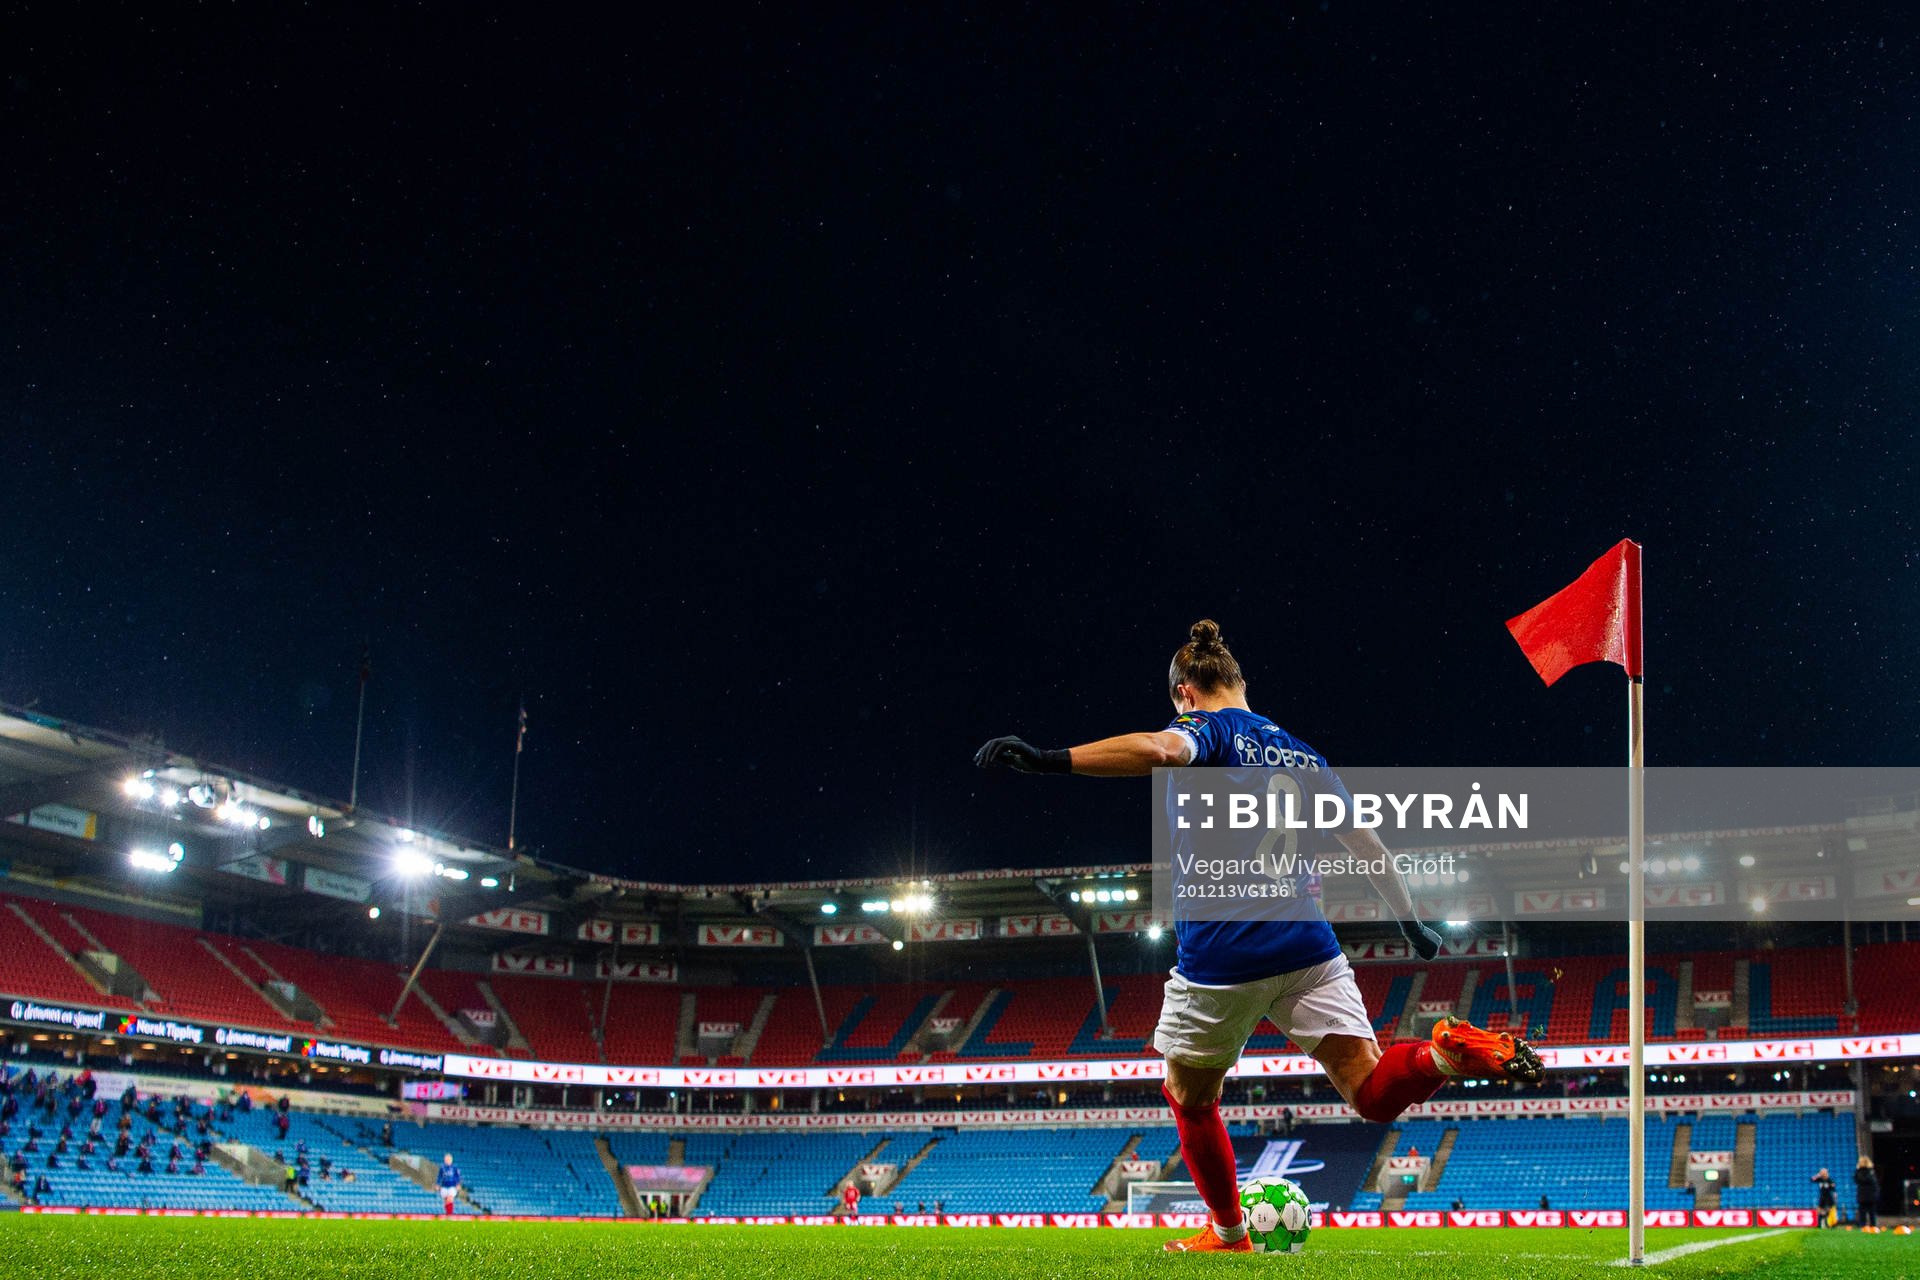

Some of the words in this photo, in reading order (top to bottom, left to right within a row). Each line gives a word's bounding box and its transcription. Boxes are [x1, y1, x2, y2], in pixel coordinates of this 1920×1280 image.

[1265, 746, 1319, 773] OBOS
[1256, 773, 1302, 880] 8
[1523, 890, 1598, 912] VG
[474, 909, 543, 934] VG
[585, 918, 652, 943] VG
[1007, 916, 1074, 937] VG
[707, 925, 777, 944] VG
[911, 920, 977, 942] VG
[498, 954, 571, 976] VG
[136, 1018, 165, 1037] Norsk
[166, 1021, 203, 1043] Tipping
[469, 1060, 512, 1078] VG
[534, 1065, 583, 1082] VG
[607, 1069, 659, 1084] VG
[684, 1071, 735, 1084] VG
[758, 1071, 806, 1085] VG
[828, 1070, 874, 1084] VG
[897, 1068, 944, 1082] VG
[966, 1066, 1015, 1080] VG
[1038, 1064, 1088, 1078] VG
[1111, 1062, 1162, 1076] VG
[1263, 1057, 1316, 1073] VG
[1668, 1045, 1727, 1061] VG
[1754, 1042, 1814, 1058] VG
[1842, 1038, 1900, 1055] VG
[441, 1107, 468, 1119] VG
[475, 1108, 508, 1120] VG
[514, 1110, 548, 1121] VG
[554, 1112, 589, 1123] VG
[596, 1113, 632, 1125] VG
[640, 1114, 675, 1126] VG
[683, 1115, 718, 1126] VG
[726, 1115, 760, 1126] VG
[766, 1115, 799, 1126] VG
[806, 1115, 838, 1126] VG
[844, 1115, 876, 1125] VG
[883, 1114, 916, 1124] VG
[923, 1113, 955, 1124] VG
[962, 1112, 996, 1122] VG
[1002, 1111, 1036, 1122] VG
[1043, 1111, 1077, 1121] VG
[1084, 1110, 1119, 1121] VG
[1125, 1109, 1160, 1120] VG
[1297, 1105, 1333, 1116] VG
[1431, 1102, 1468, 1113] VG
[1477, 1101, 1514, 1112] VG
[1523, 1100, 1560, 1111] VG
[1569, 1099, 1608, 1110] VG
[1663, 1097, 1703, 1108] VG
[1711, 1095, 1752, 1107] VG
[1760, 1094, 1801, 1106] VG
[1809, 1093, 1850, 1105] VG
[893, 1215, 938, 1227] VG
[944, 1215, 992, 1227] VG
[995, 1215, 1044, 1228] VG
[1051, 1214, 1100, 1228] VG
[1105, 1214, 1154, 1228] VG
[1331, 1213, 1382, 1227] VG
[1389, 1213, 1441, 1227] VG
[1449, 1212, 1502, 1227] VG
[1509, 1212, 1561, 1227] VG
[1569, 1211, 1624, 1227] VG
[1695, 1211, 1749, 1227] VG
[1757, 1210, 1815, 1227] VG
